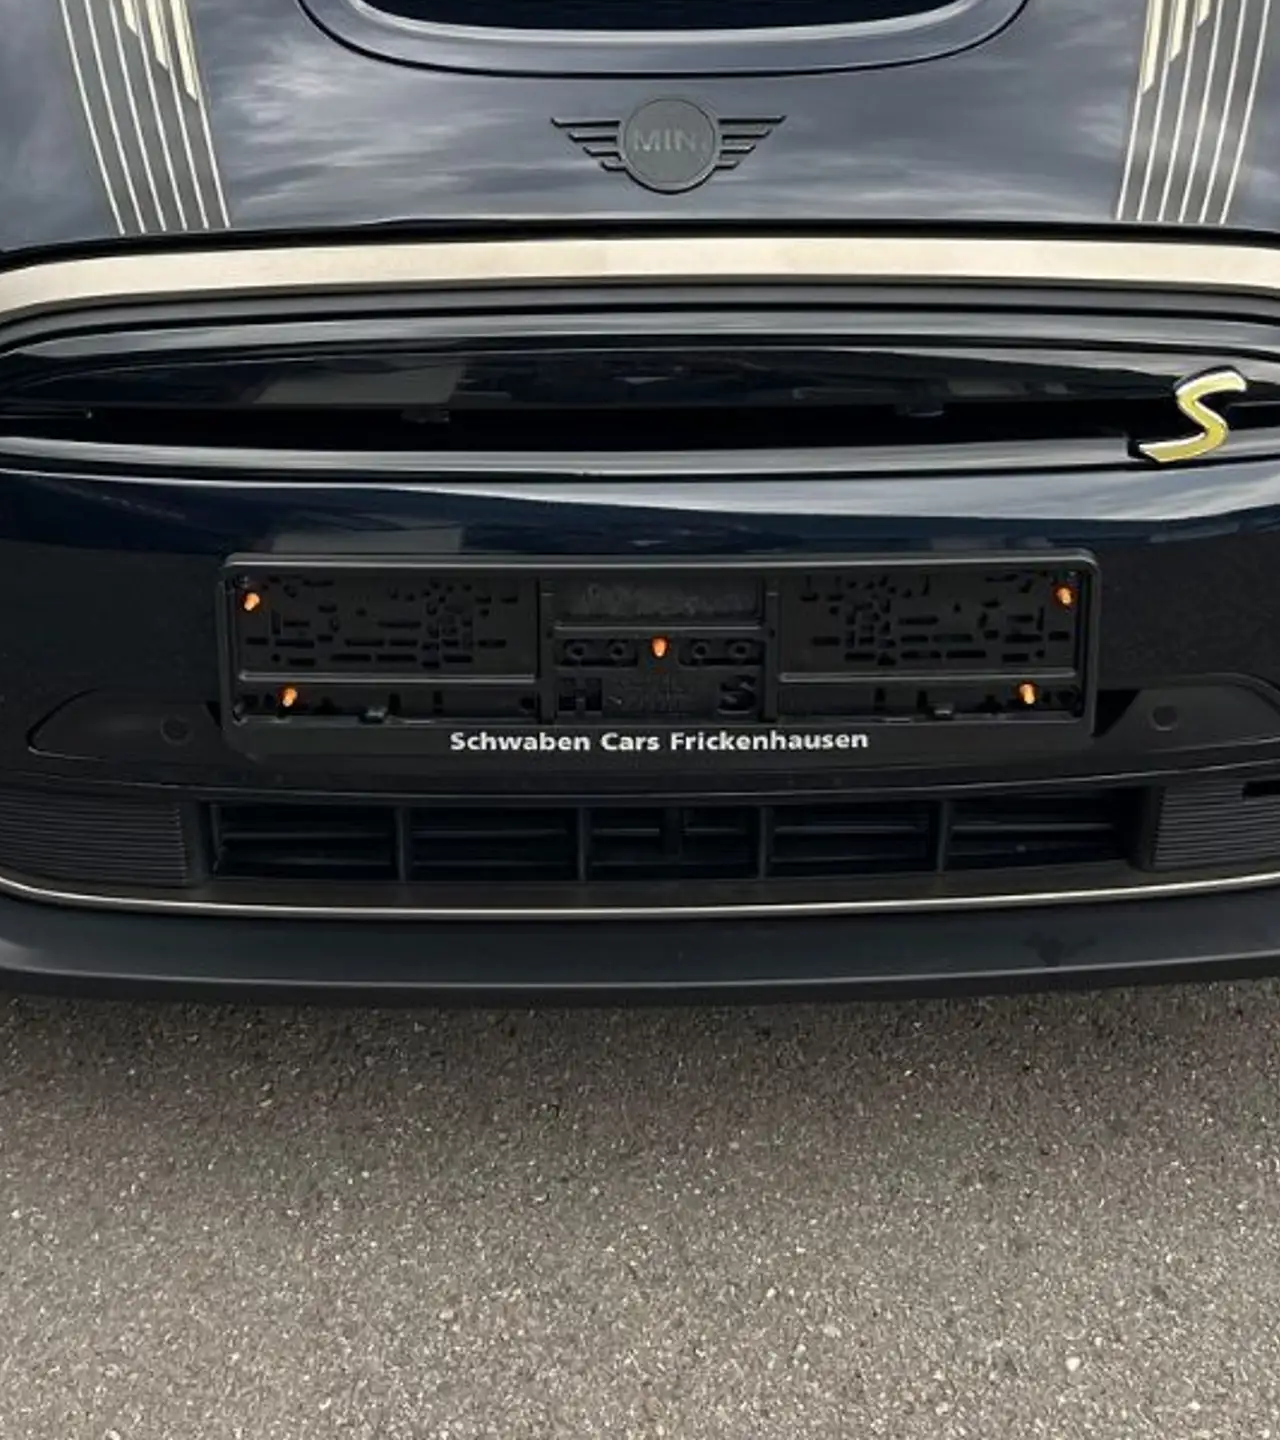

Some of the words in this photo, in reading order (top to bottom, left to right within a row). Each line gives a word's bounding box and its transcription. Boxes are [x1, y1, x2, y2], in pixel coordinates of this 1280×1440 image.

[1138, 370, 1248, 463] S
[449, 732, 591, 751] Schwaben
[600, 732, 660, 751] Cars
[670, 731, 870, 751] Frickenhausen
